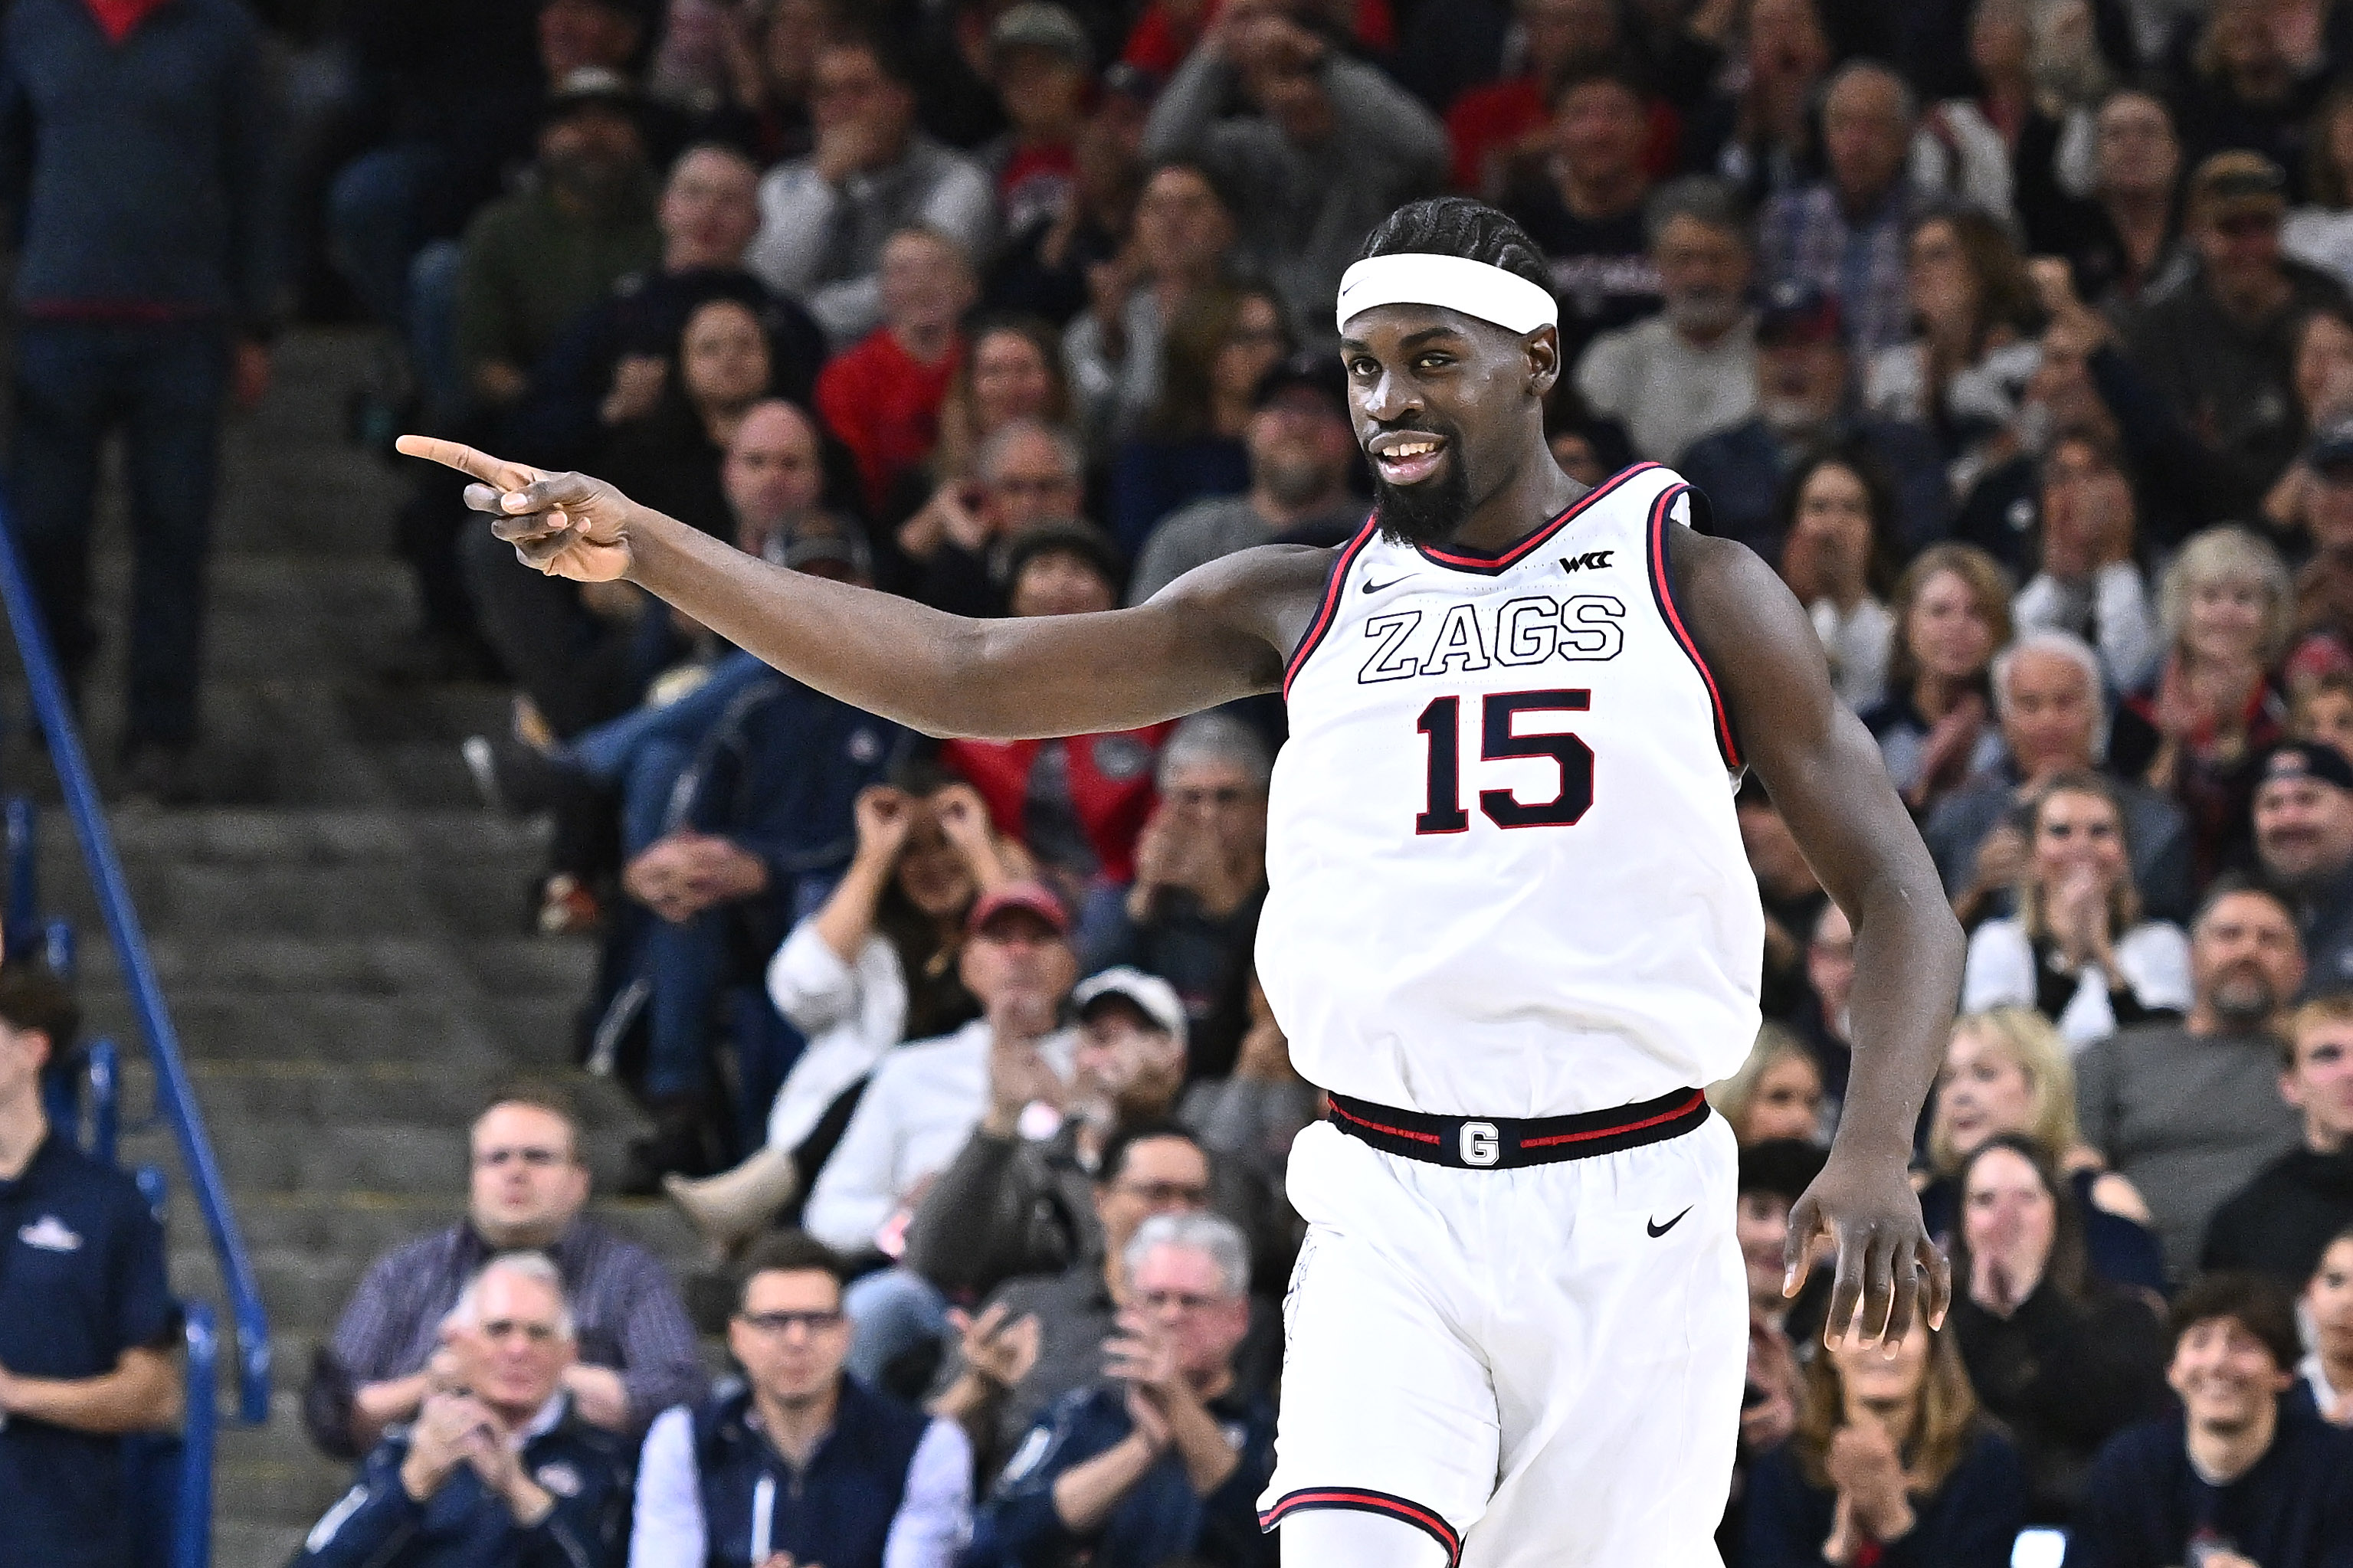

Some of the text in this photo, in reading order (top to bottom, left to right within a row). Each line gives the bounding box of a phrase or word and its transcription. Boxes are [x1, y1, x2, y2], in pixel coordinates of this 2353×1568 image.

[1559, 551, 1614, 574] WCC
[1358, 595, 1625, 684] ZAGS
[1416, 689, 1594, 835] 15
[1460, 1121, 1499, 1166] G
